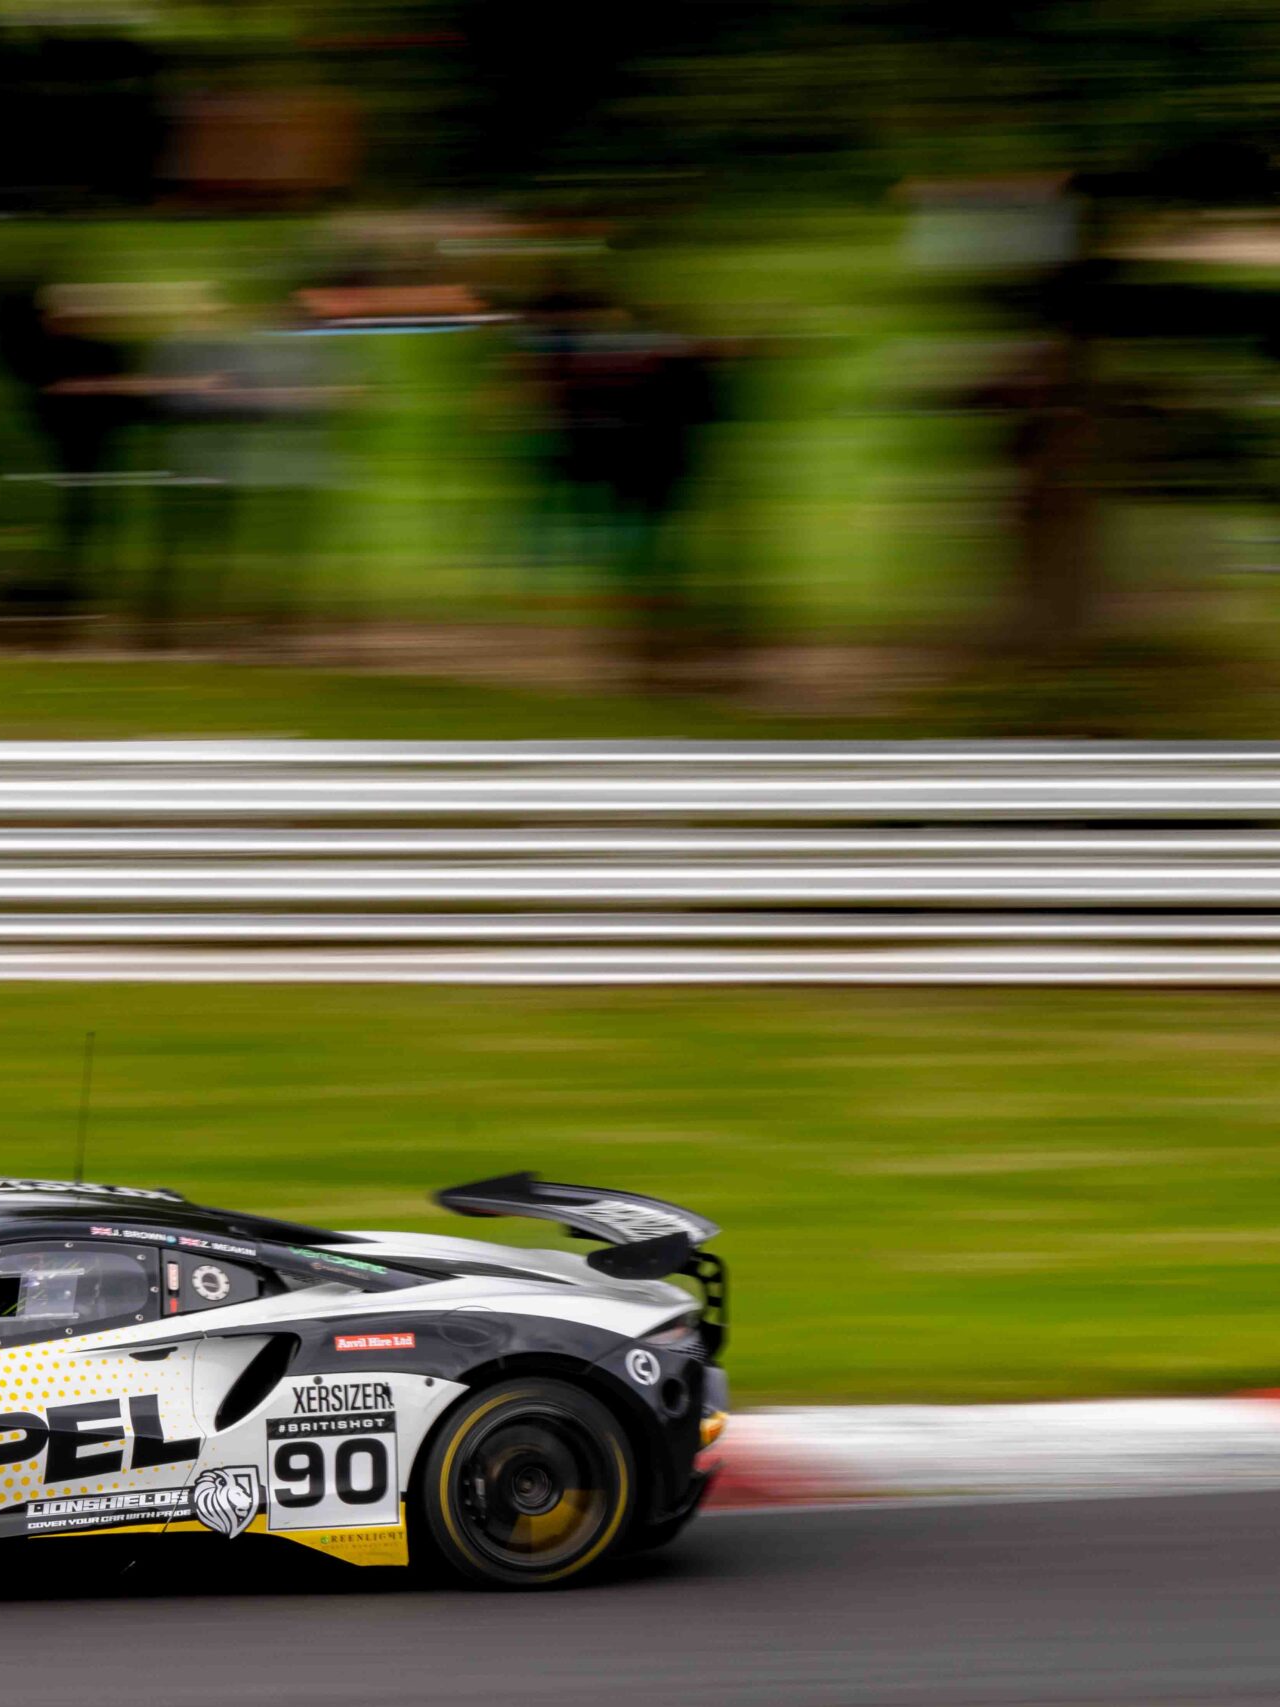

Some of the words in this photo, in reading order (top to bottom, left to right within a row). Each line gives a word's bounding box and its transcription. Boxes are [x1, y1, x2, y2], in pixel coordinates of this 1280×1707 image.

[338, 1338, 367, 1348] Anvil
[368, 1337, 392, 1347] Hire
[393, 1336, 413, 1345] Ltd
[292, 1383, 387, 1414] XERSIZER
[278, 1418, 385, 1433] #BRITISHGT
[274, 1438, 388, 1508] 90
[26, 1489, 189, 1518] LIONSHIELDS
[28, 1520, 66, 1529] COVER
[68, 1517, 99, 1526] YOUR
[101, 1515, 125, 1523] CAR
[126, 1512, 155, 1520] WITH
[155, 1509, 191, 1518] PRIDE
